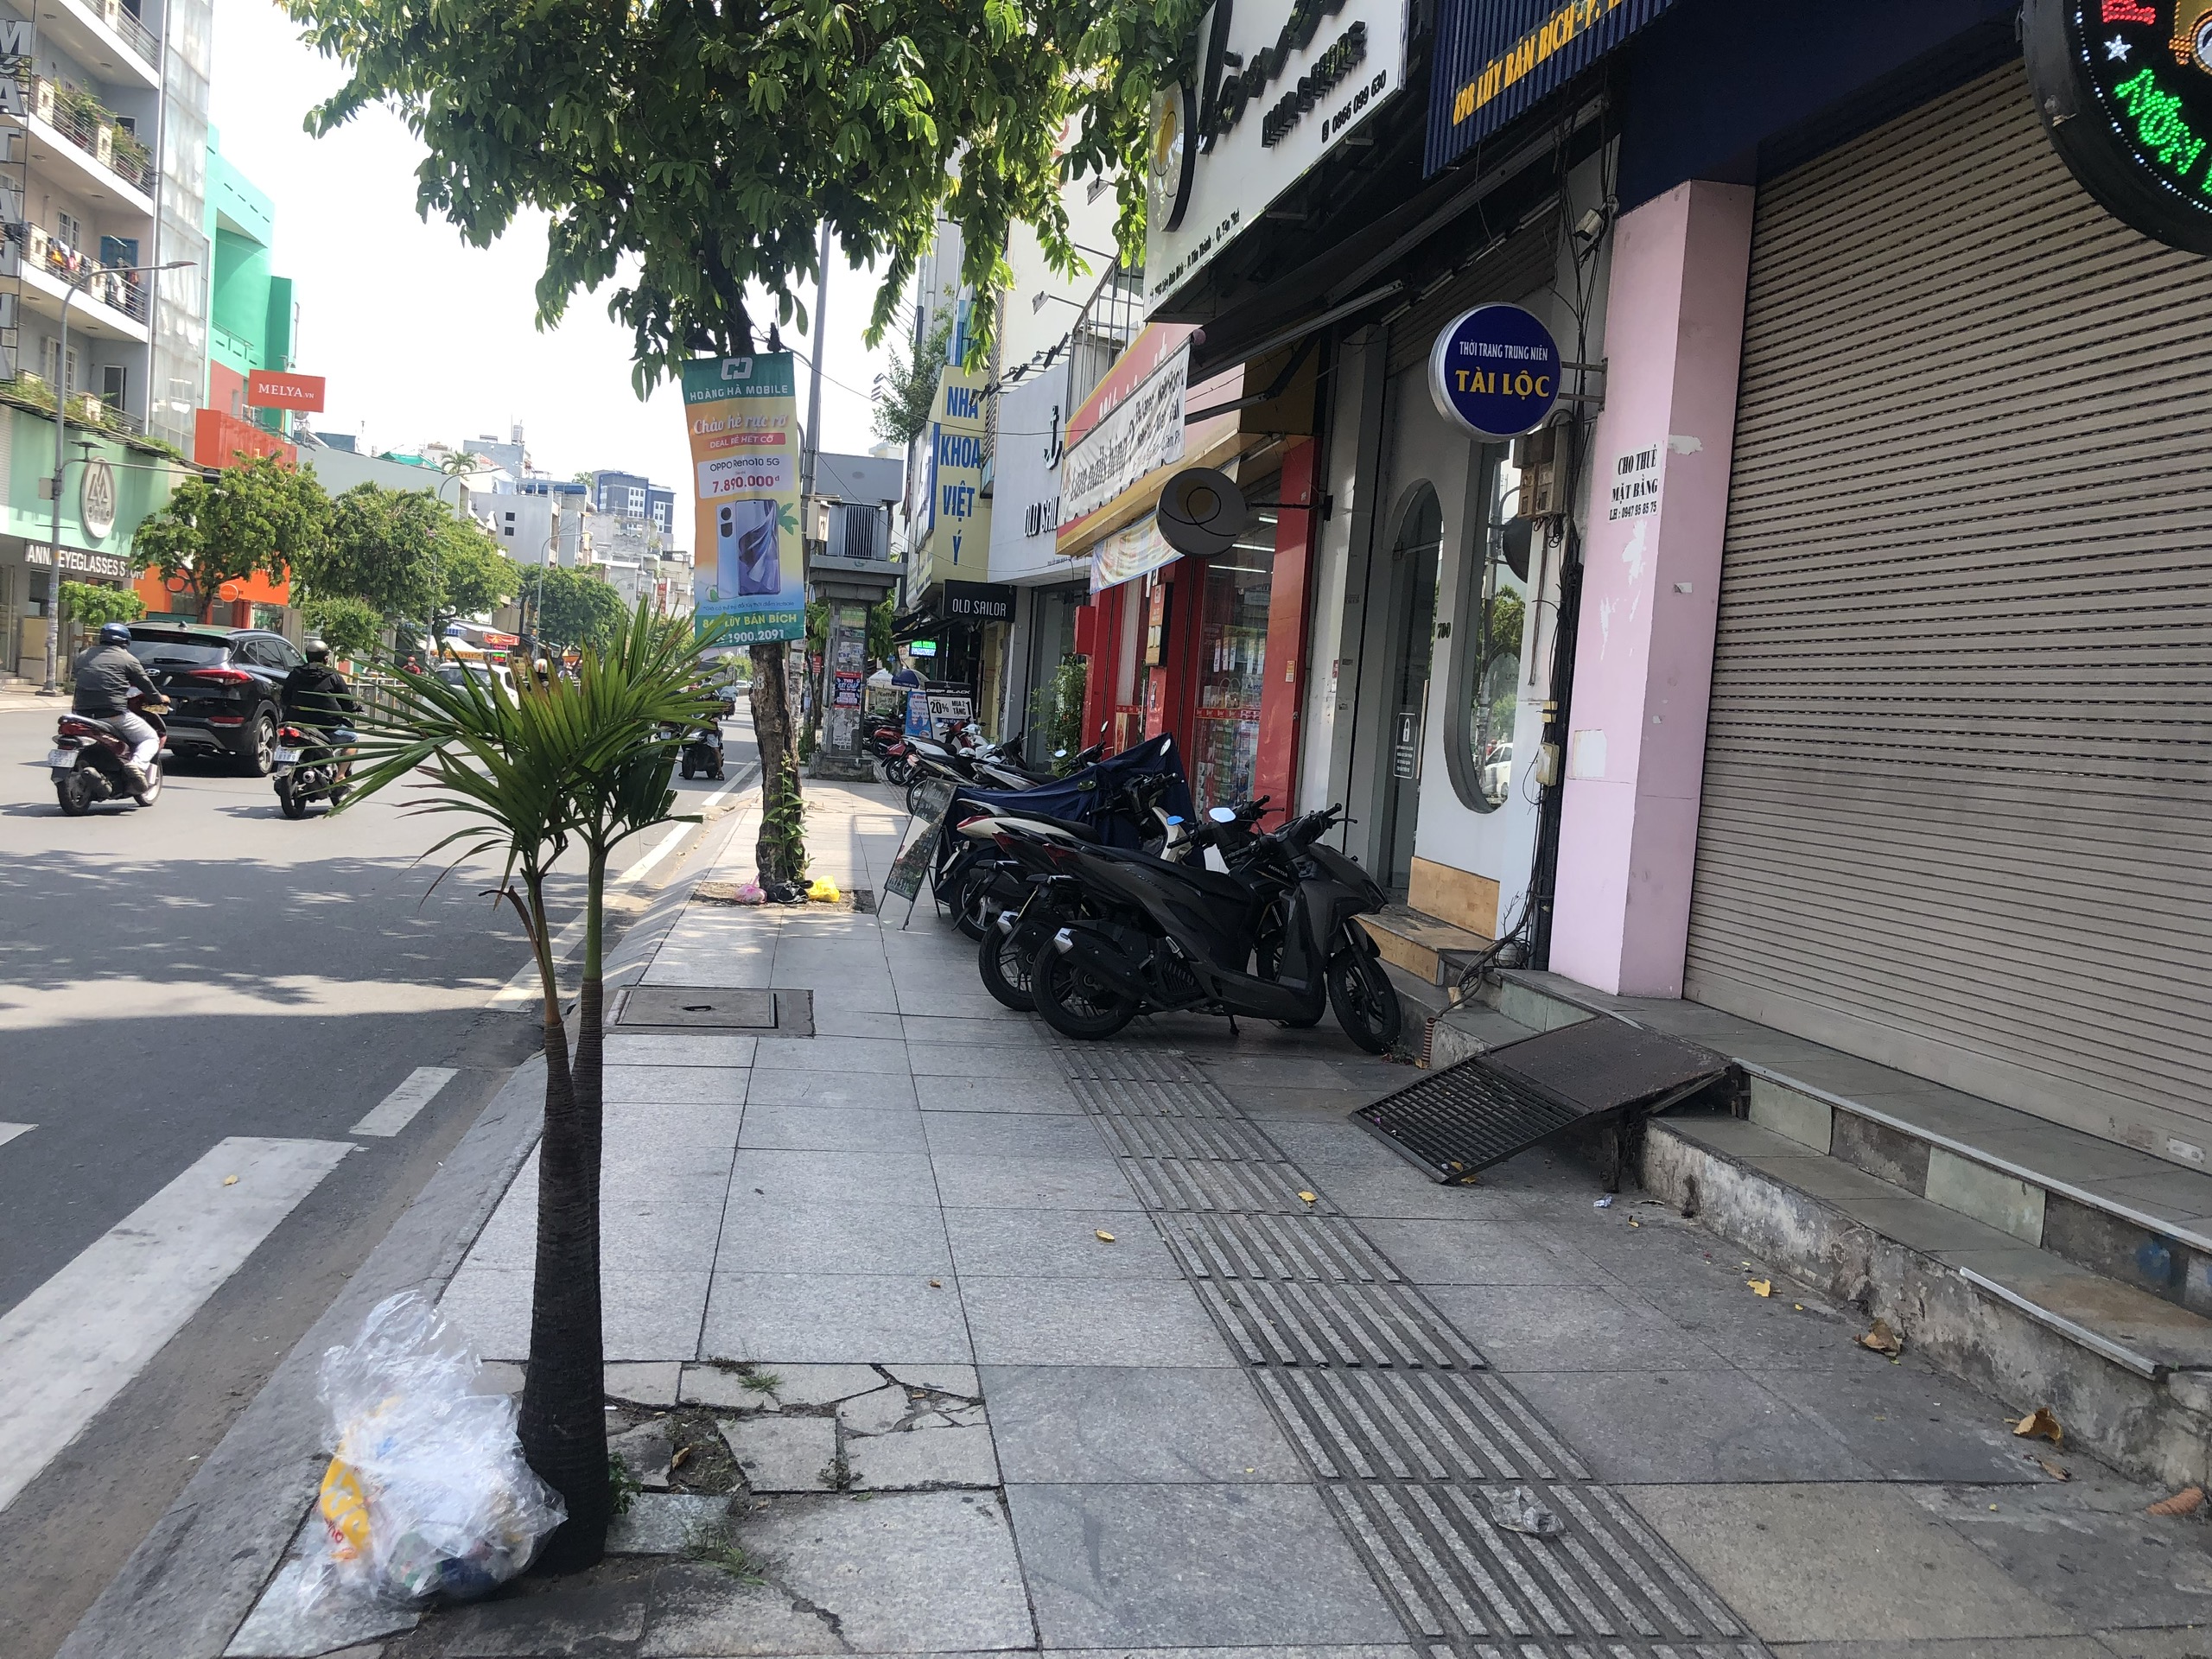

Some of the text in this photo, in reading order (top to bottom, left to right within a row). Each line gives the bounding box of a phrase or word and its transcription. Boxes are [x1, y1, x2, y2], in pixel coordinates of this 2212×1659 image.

[1504, 36, 1536, 87] BÁN
[1537, 4, 1575, 63] BÍCH
[1353, 85, 1370, 115] 099
[1370, 69, 1387, 98] 630
[1459, 339, 1548, 361] THỜI TRANG TRUNG NIÊN
[690, 385, 788, 401] HOÀNG HÀ MOBILE
[1455, 366, 1550, 401] TÀI LỘC
[946, 386, 979, 420] NHA
[694, 413, 788, 435] Chào hè rực rỡ
[709, 439, 728, 448] DEAL
[730, 434, 739, 445] RẺ
[760, 435, 773, 443] CỠ
[940, 435, 981, 469] KHOA
[709, 458, 780, 472] OPPO Reno10 5G
[1618, 443, 1657, 475] CHO THUÊ
[943, 480, 975, 522] VIỆT
[1611, 474, 1658, 505] MẶT BẰNG
[1024, 495, 1058, 537] OLD SAIL
[1621, 505, 1634, 518] 0947
[25, 544, 54, 566] ANN
[59, 550, 118, 576] EYEGLASSES
[952, 529, 962, 566] Ý
[744, 613, 766, 626] BÁN
[768, 612, 797, 624] BÍCH
[952, 598, 1007, 617] OLD SAILOR
[728, 629, 785, 644] 1900.2091
[930, 701, 950, 714] 20%
[1268, 863, 1288, 878] HONDA
